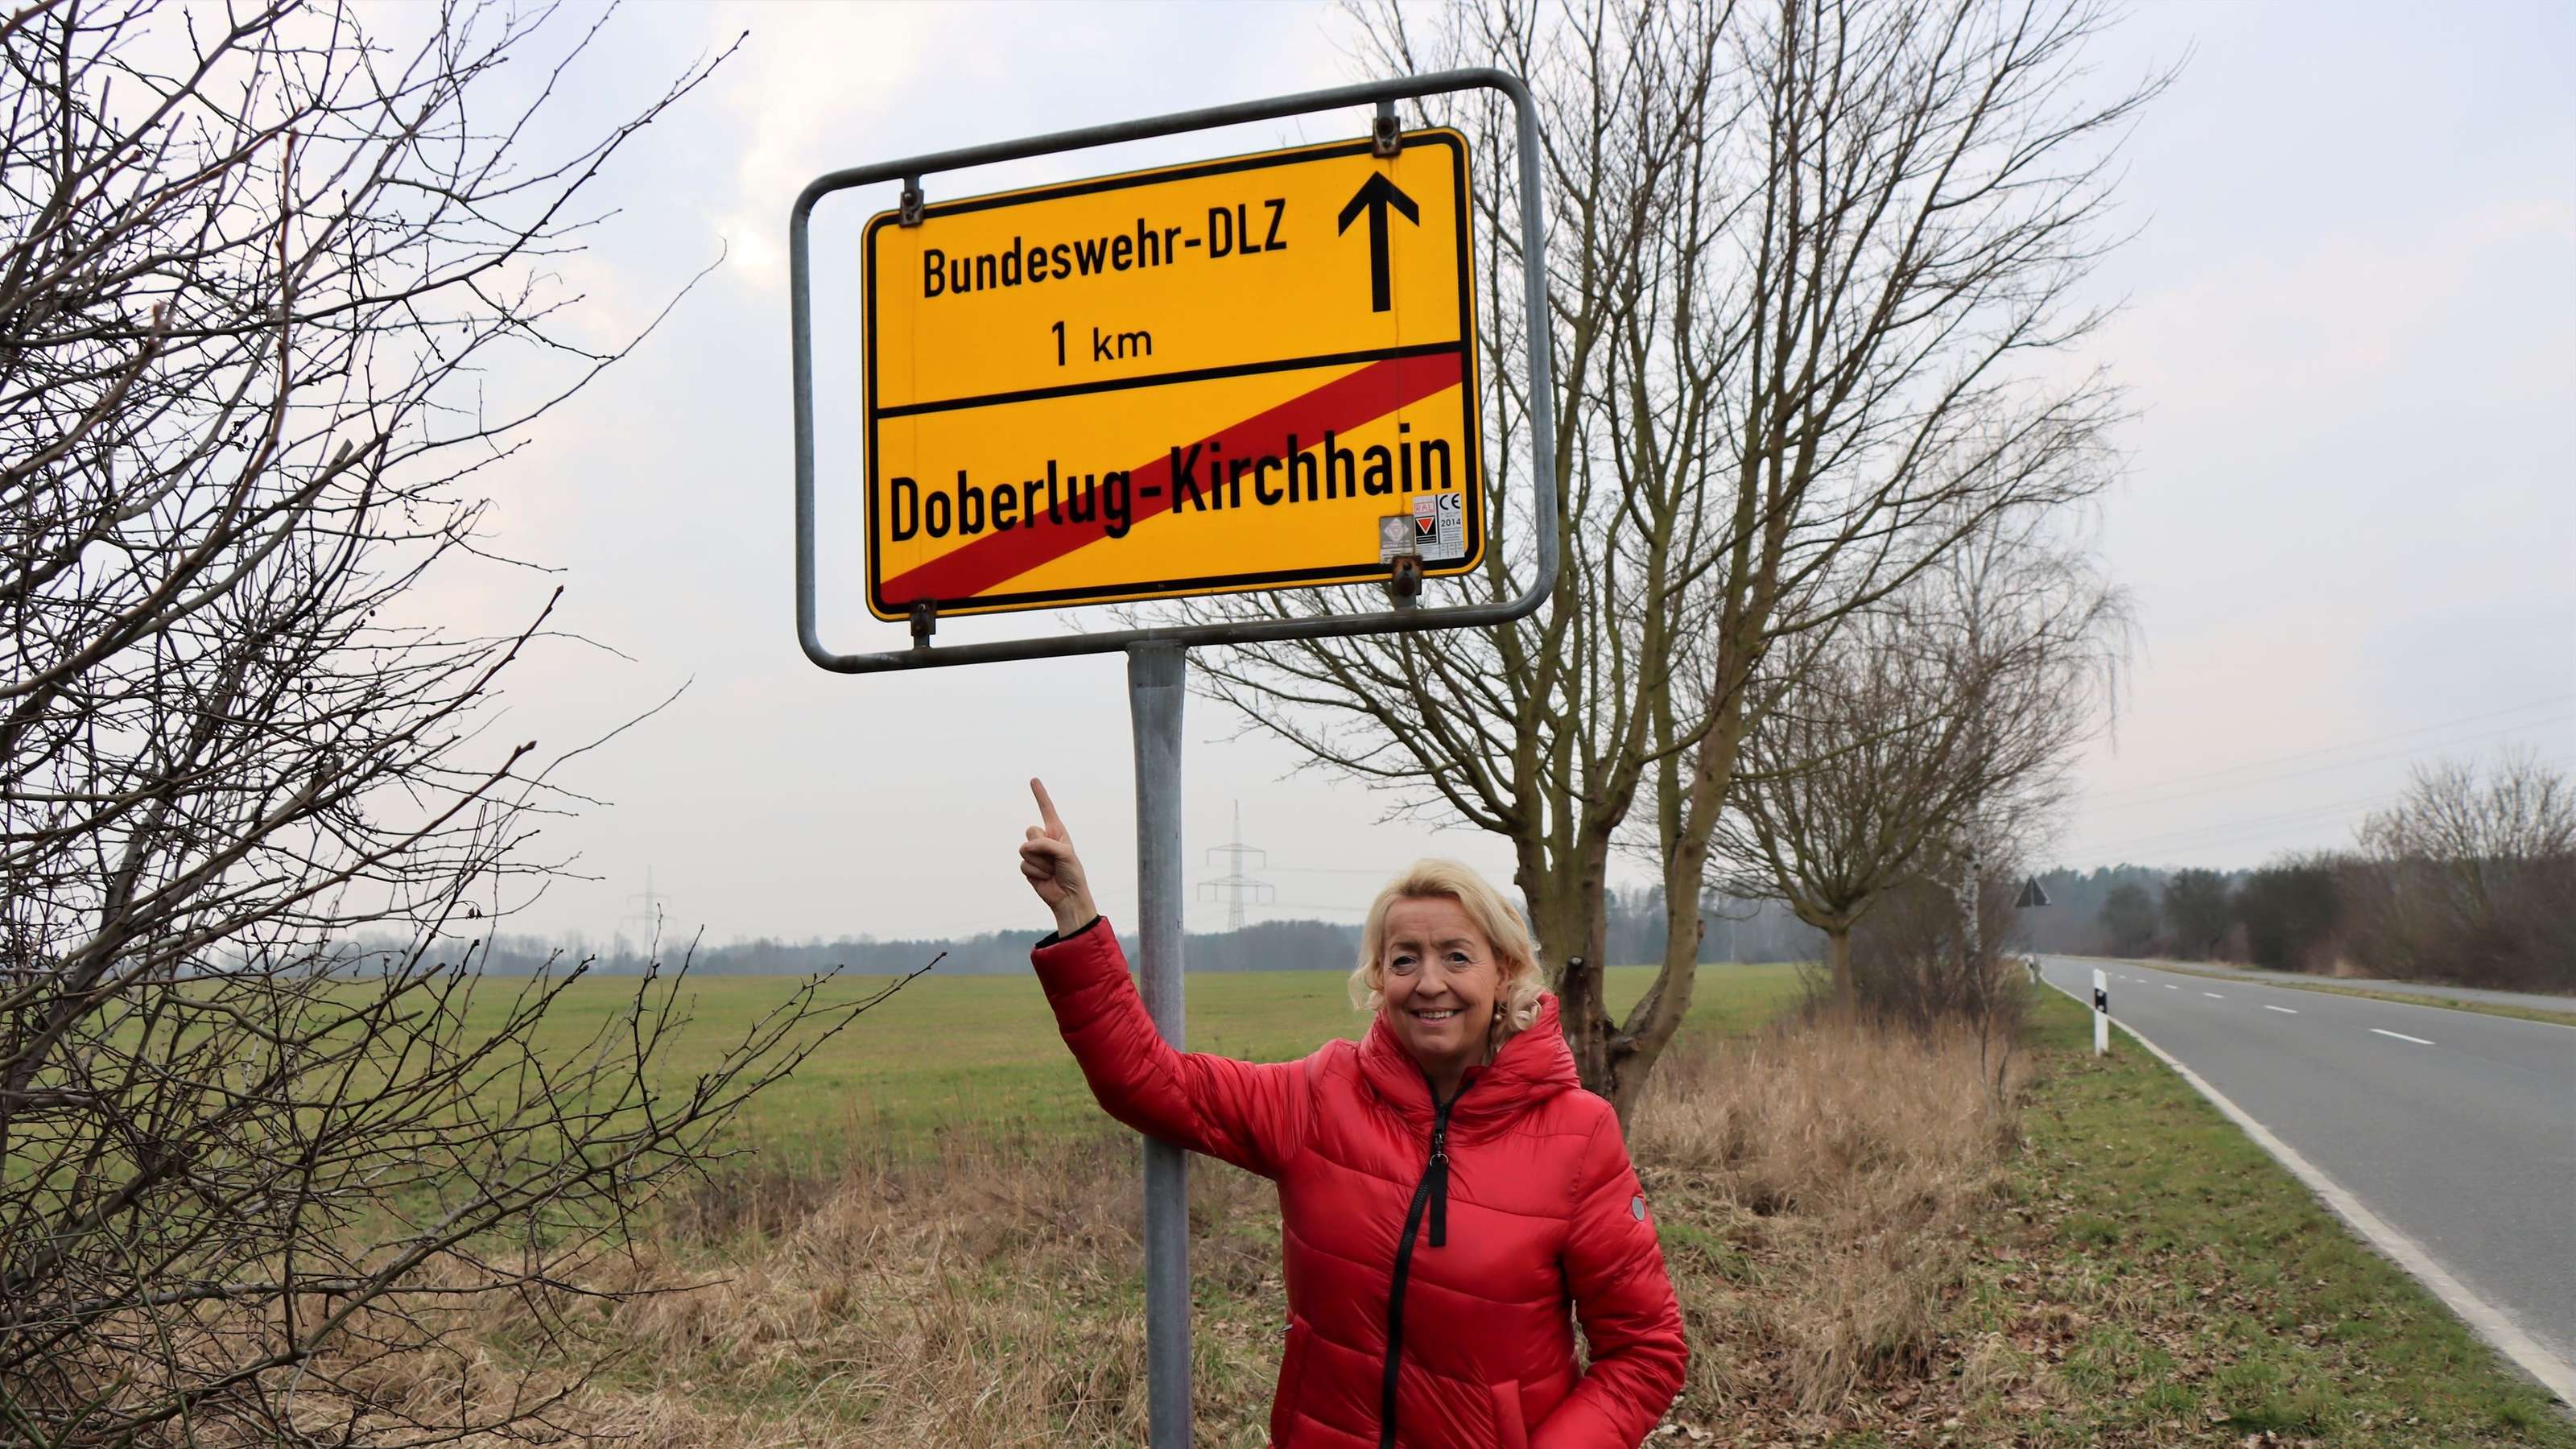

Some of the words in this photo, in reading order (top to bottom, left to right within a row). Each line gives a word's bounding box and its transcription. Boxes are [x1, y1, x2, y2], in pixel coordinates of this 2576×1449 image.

[923, 198, 1288, 299] Bundeswehr-DLZ
[1051, 320, 1067, 367] 1
[1093, 327, 1153, 362] km
[890, 423, 1452, 543] Doberlug-Kirchhain
[1415, 503, 1433, 512] RAL
[1439, 493, 1460, 510] CE
[1441, 518, 1461, 527] 2014
